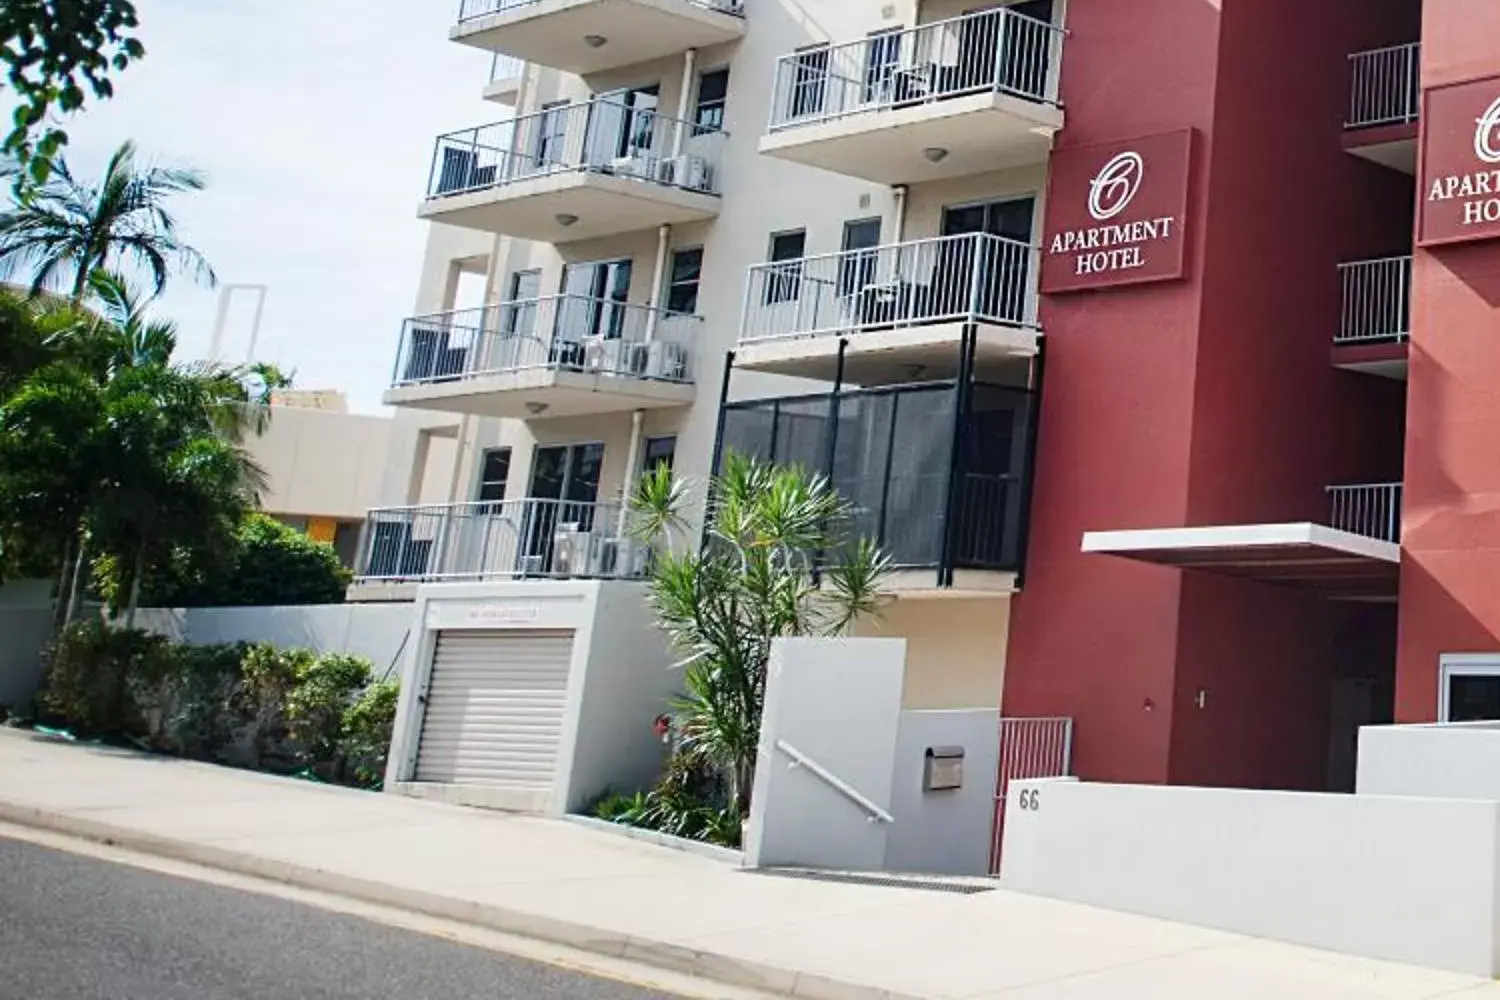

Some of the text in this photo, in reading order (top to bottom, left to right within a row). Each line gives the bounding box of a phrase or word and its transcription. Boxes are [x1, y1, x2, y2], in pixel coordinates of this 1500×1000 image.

[1050, 217, 1174, 253] APARTMENT
[1075, 247, 1145, 275] HOTEL
[1019, 788, 1039, 811] 66
